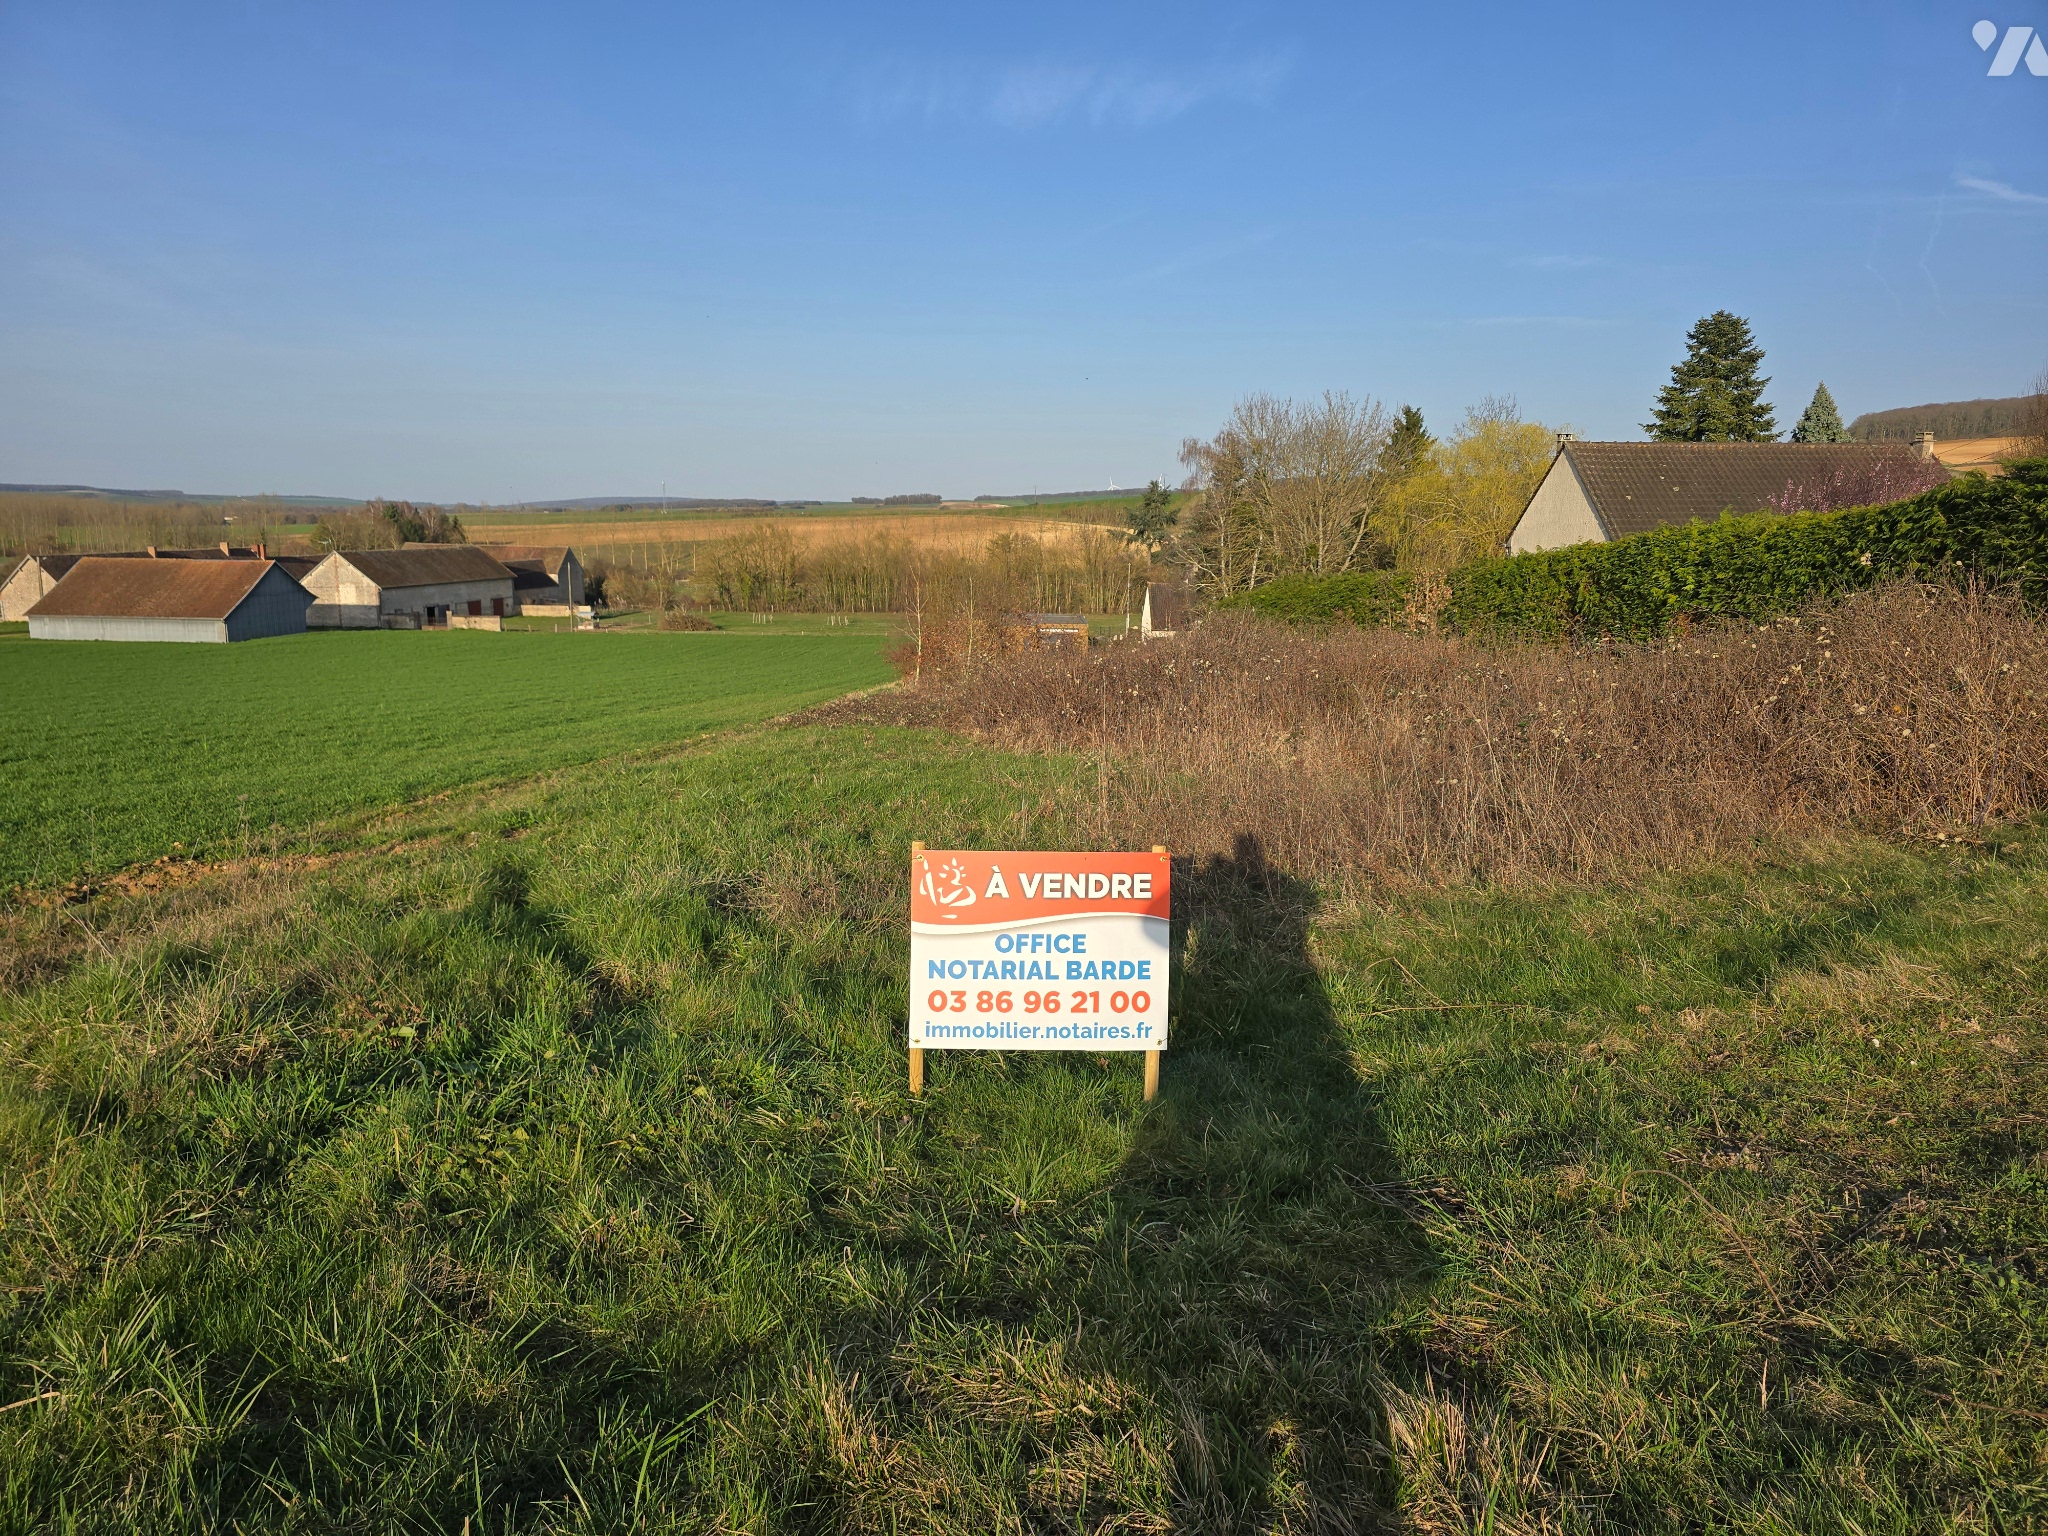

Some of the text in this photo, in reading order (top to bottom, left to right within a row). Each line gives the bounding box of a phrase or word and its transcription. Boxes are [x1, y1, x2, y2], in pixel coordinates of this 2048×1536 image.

[984, 864, 1152, 899] À VENDRE
[994, 933, 1087, 954] OFFICE
[928, 959, 1151, 980] NOTARIAL BARDE
[927, 989, 1151, 1013] 03 86 96 21 00
[925, 1020, 1152, 1039] immobilier.notaires.fr
